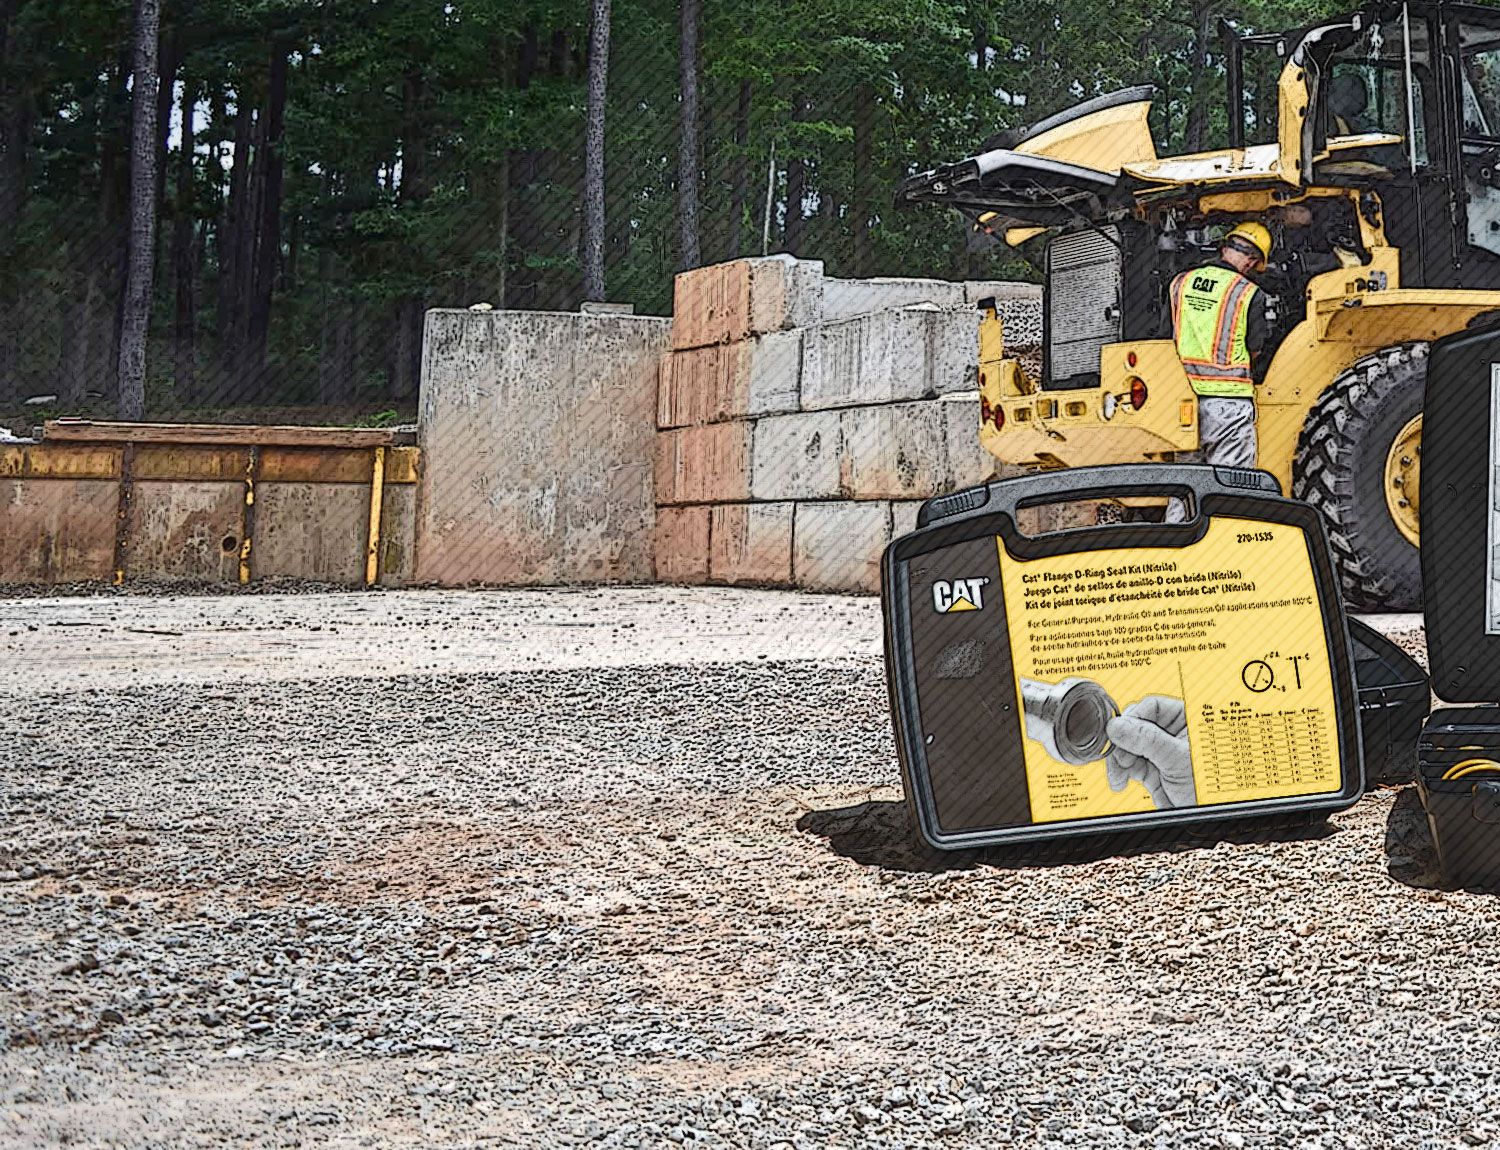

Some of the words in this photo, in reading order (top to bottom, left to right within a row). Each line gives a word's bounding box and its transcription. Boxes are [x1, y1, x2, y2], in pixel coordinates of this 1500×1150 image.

[1192, 277, 1218, 292] CAT
[1236, 532, 1273, 543] 270-1535
[1024, 588, 1051, 597] Juego
[1075, 583, 1086, 593] de
[1087, 581, 1114, 591] sellos
[1116, 579, 1127, 589] de
[1166, 576, 1182, 585] con
[1184, 572, 1206, 583] brida
[1208, 570, 1242, 581] (Nitrilo)
[1043, 572, 1073, 582] Flange
[1107, 565, 1126, 576] Seal
[1128, 564, 1141, 574] Kit
[1142, 562, 1177, 574] (Nitrile)
[932, 577, 985, 615] CAT
[1026, 600, 1039, 610] Kit
[1040, 600, 1051, 609] de
[1053, 597, 1074, 609] joint
[1075, 595, 1107, 606] torique
[1164, 589, 1175, 598] de
[1177, 586, 1200, 596] bride
[1221, 581, 1256, 593] (Nitrile)
